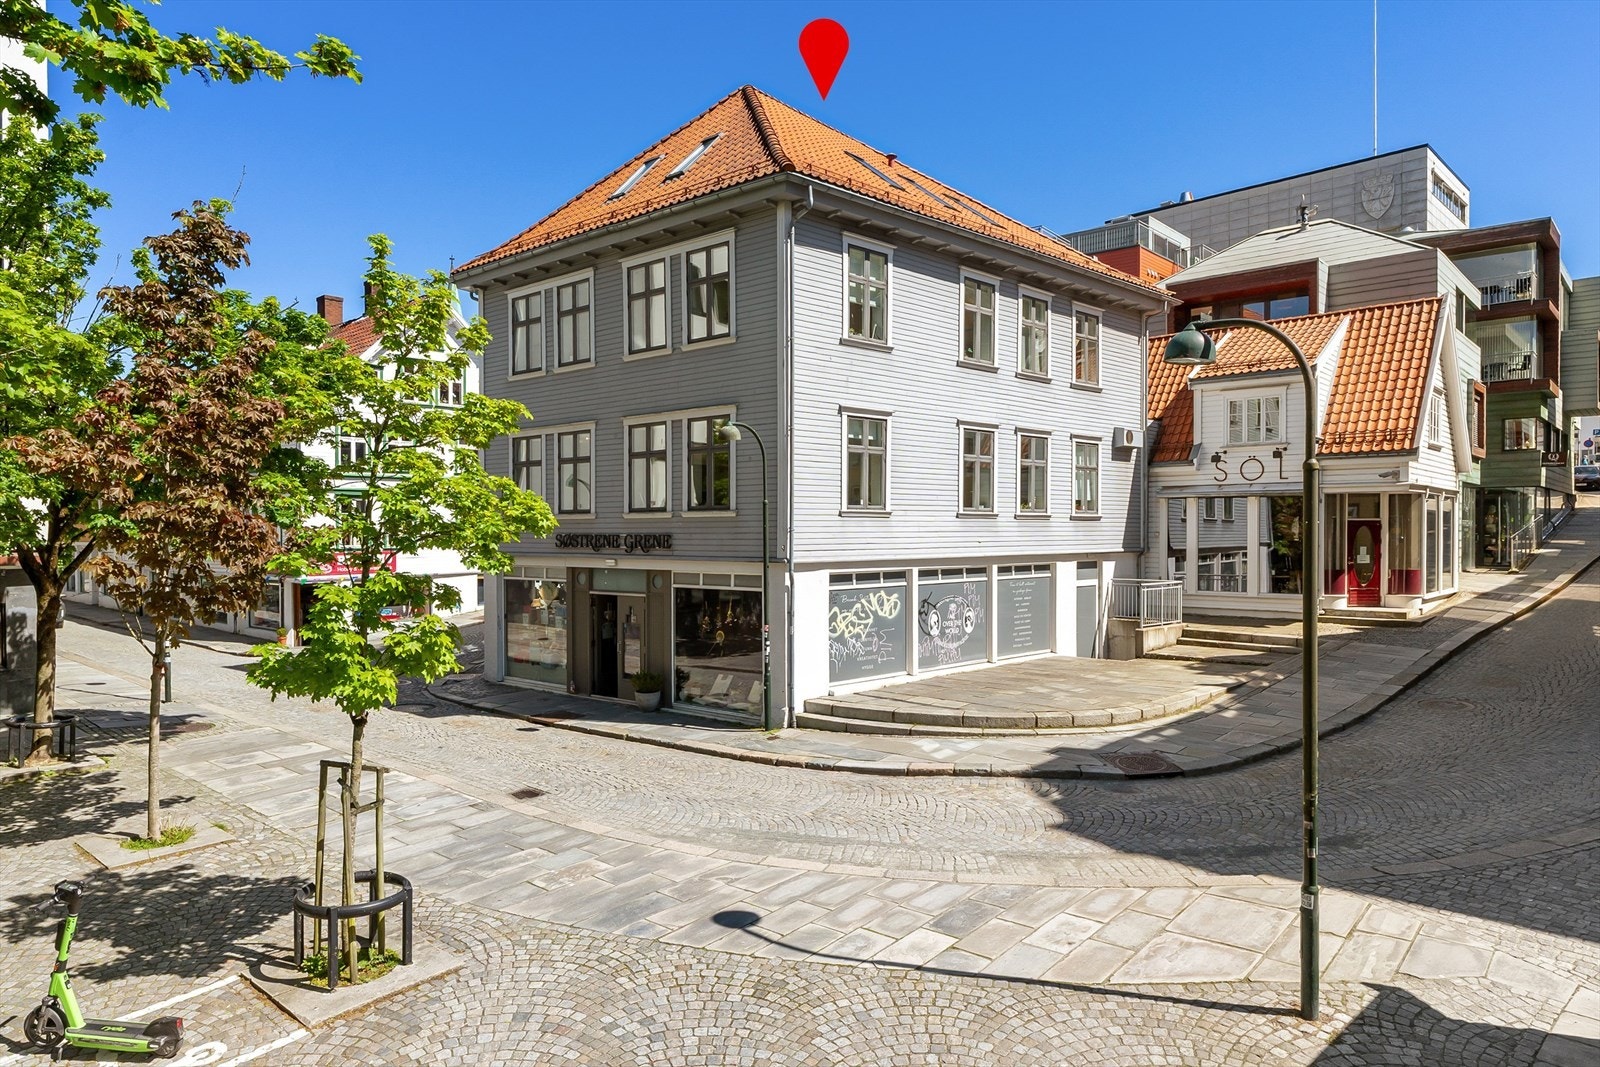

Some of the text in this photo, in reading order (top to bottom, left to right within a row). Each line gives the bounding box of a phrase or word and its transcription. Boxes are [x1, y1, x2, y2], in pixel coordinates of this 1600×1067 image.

[1214, 455, 1289, 482] SÖL
[555, 533, 672, 553] SØSTRENE GRENE
